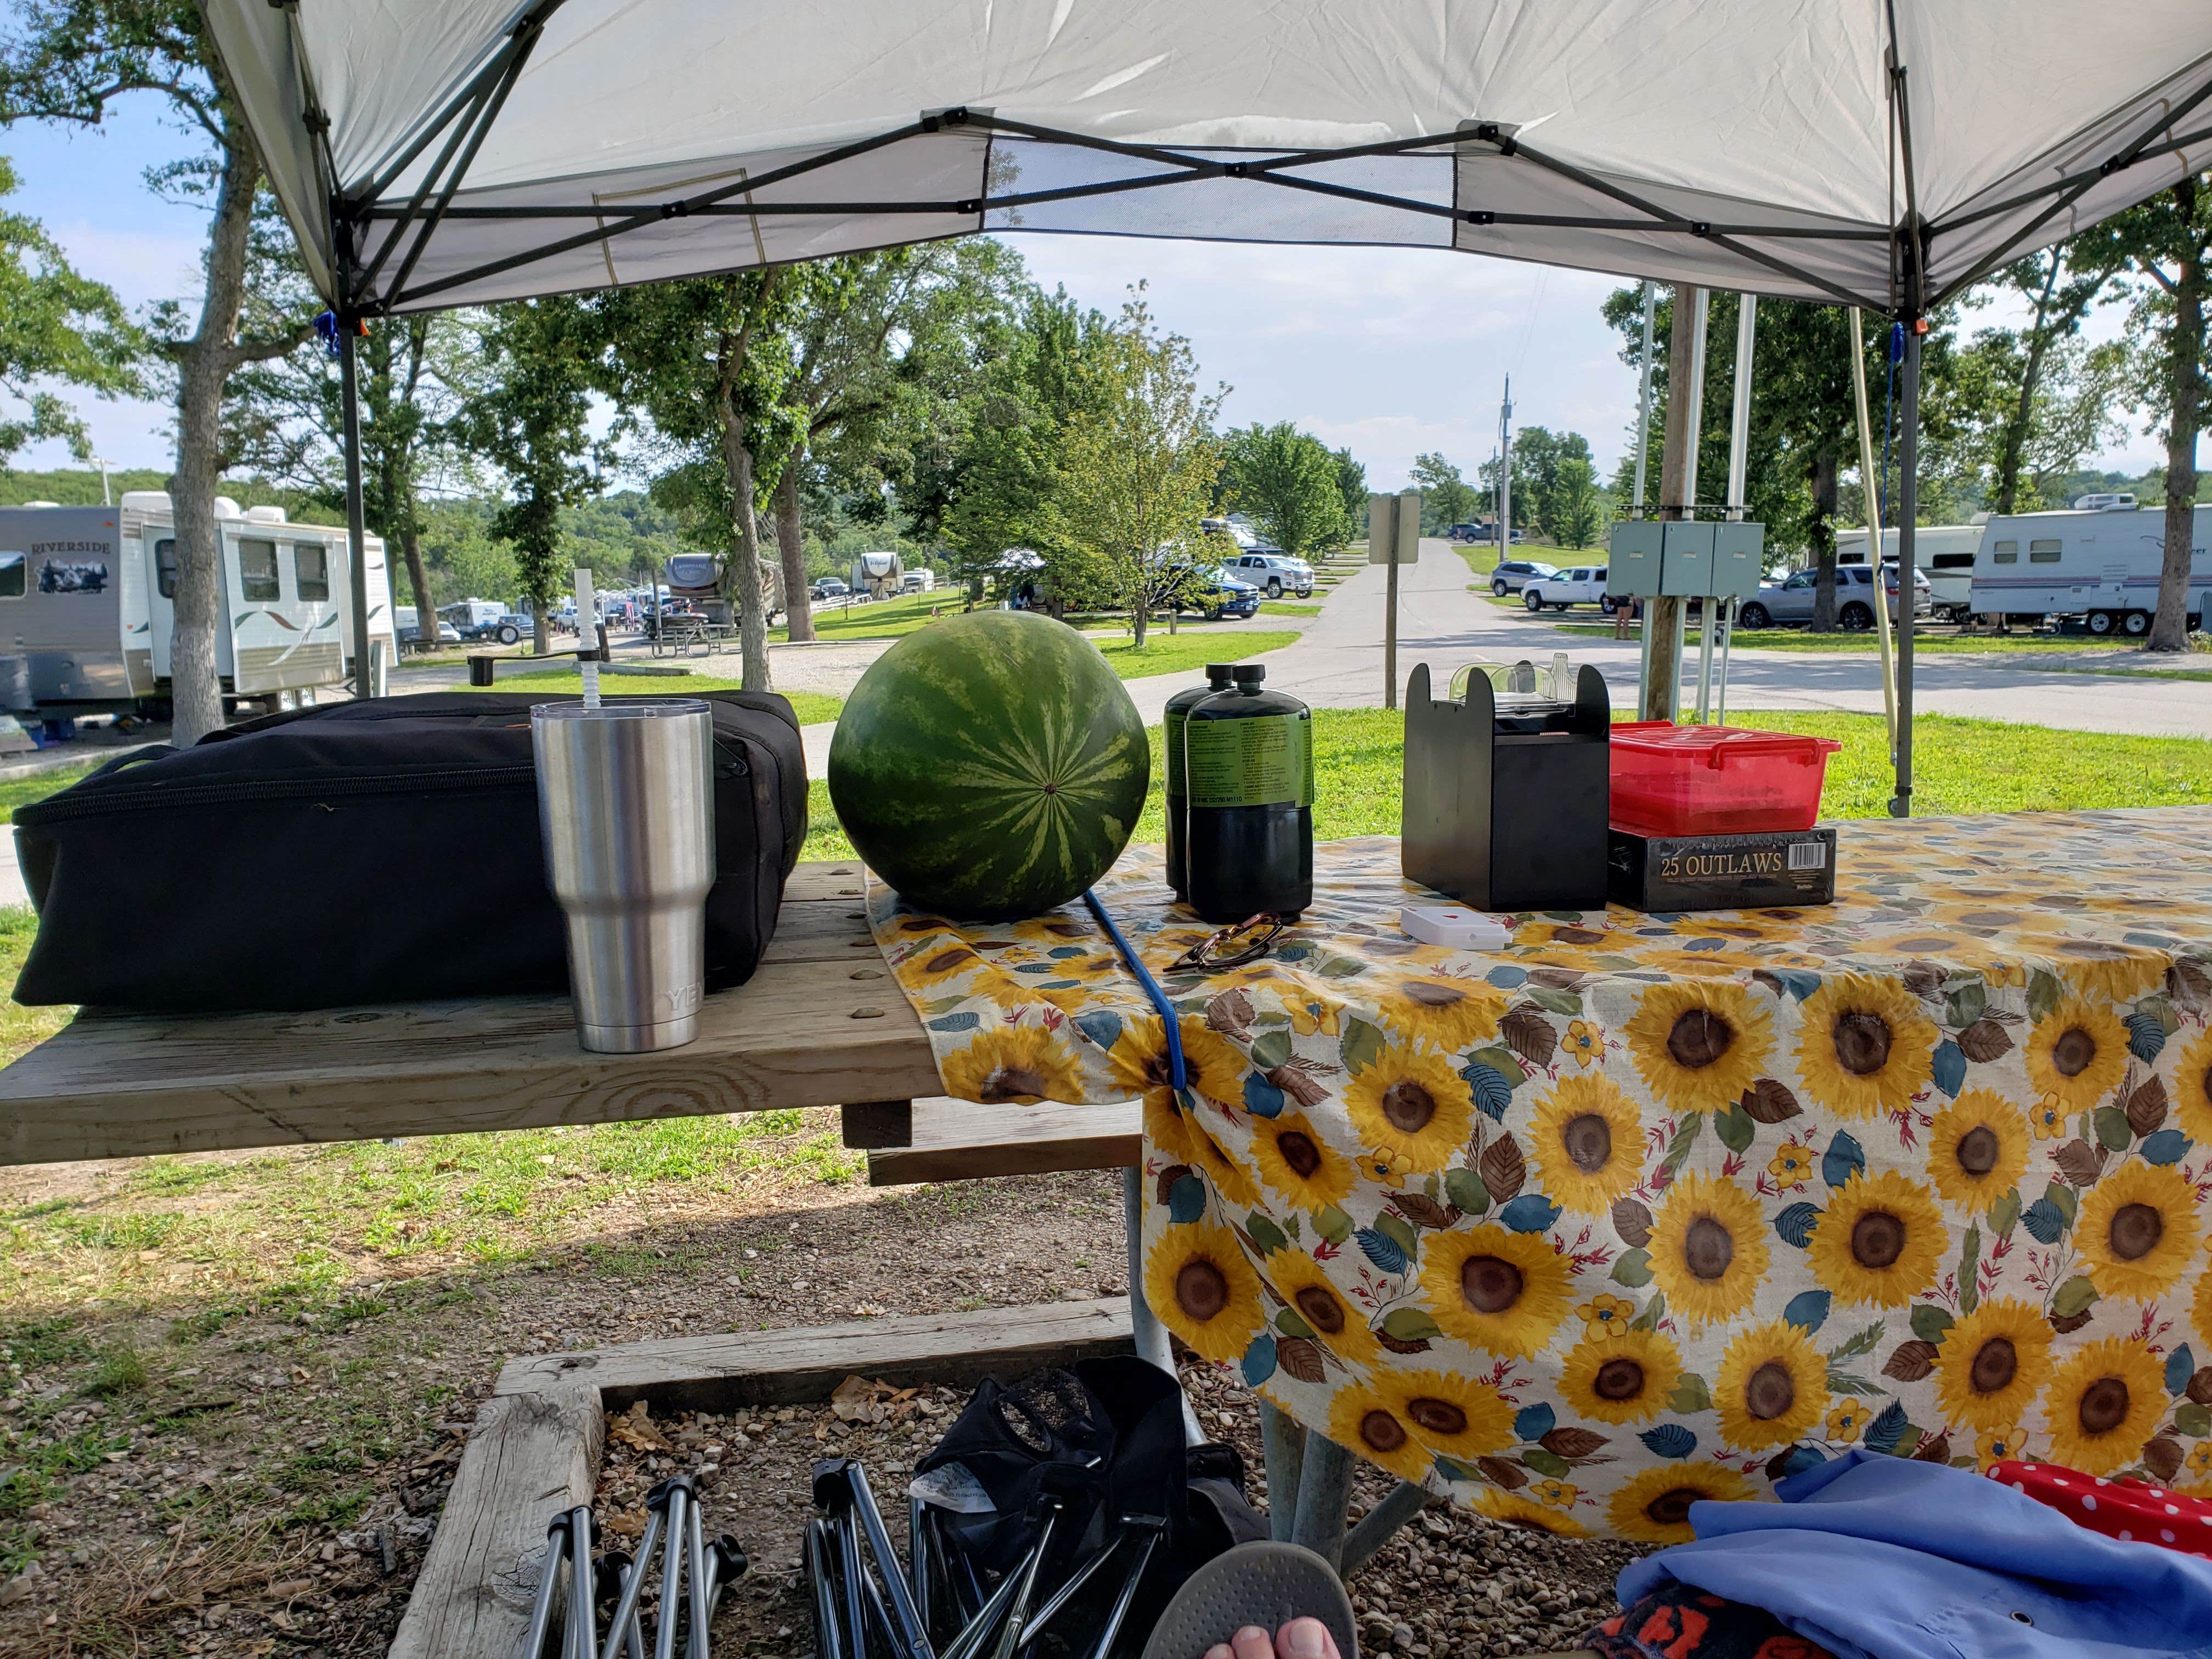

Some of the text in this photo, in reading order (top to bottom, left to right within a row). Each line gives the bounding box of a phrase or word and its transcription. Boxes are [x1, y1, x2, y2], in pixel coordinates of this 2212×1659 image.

[31, 541, 111, 555] RIVERSIDE
[1661, 853, 1782, 876] 25 OUTLAWS
